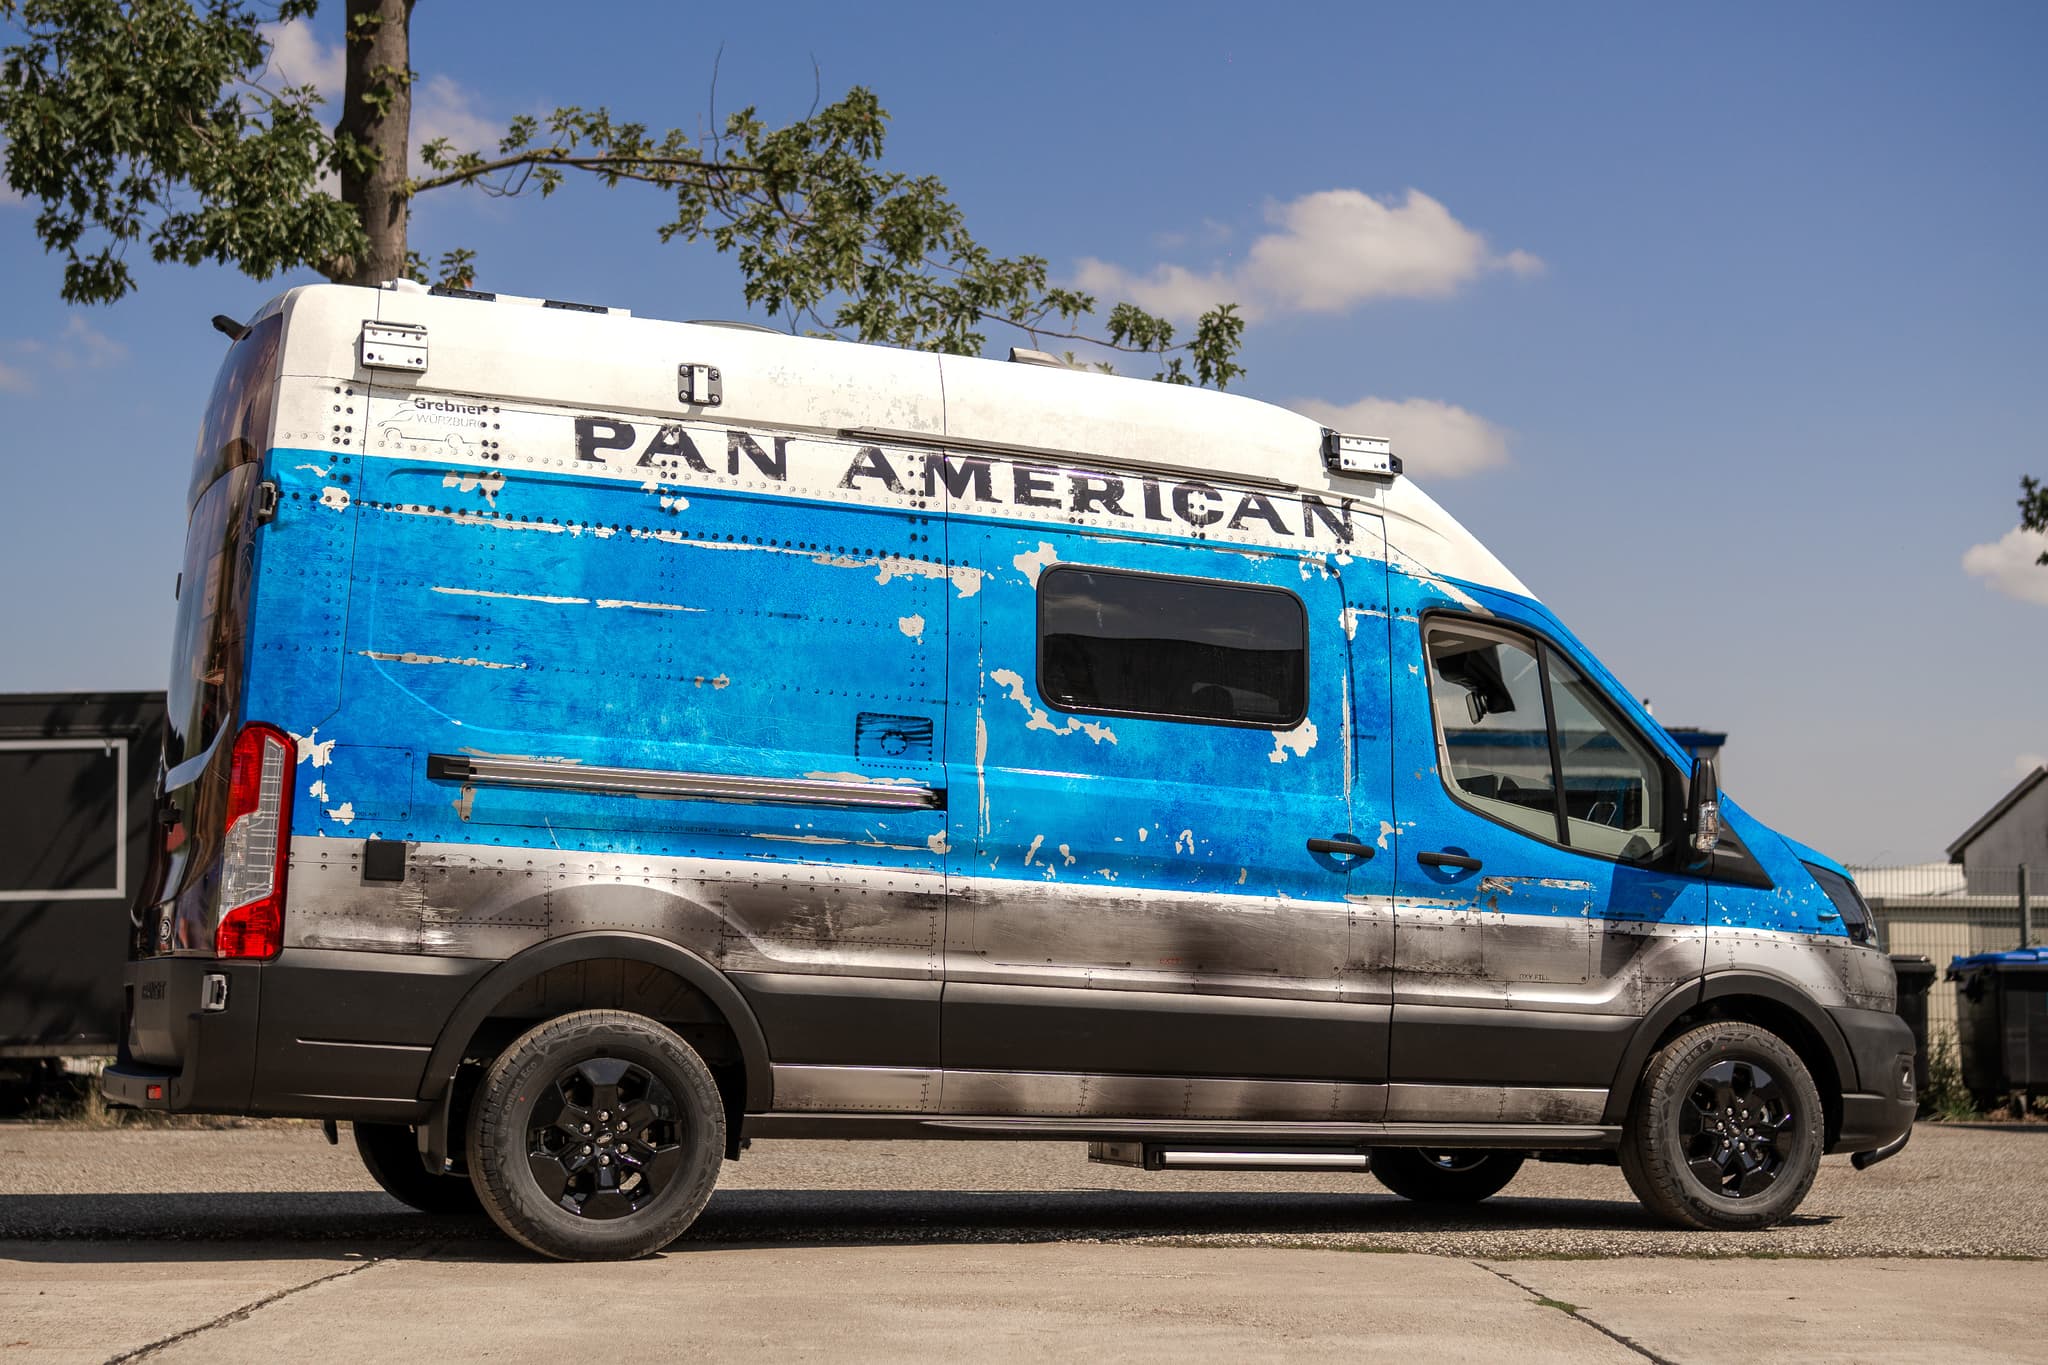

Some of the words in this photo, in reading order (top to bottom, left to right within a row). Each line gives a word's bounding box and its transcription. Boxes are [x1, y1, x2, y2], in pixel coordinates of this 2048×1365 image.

[415, 397, 482, 416] Grebner
[574, 415, 797, 482] PAN
[837, 446, 1361, 544] AMERICAN
[519, 1061, 538, 1079] Eco
